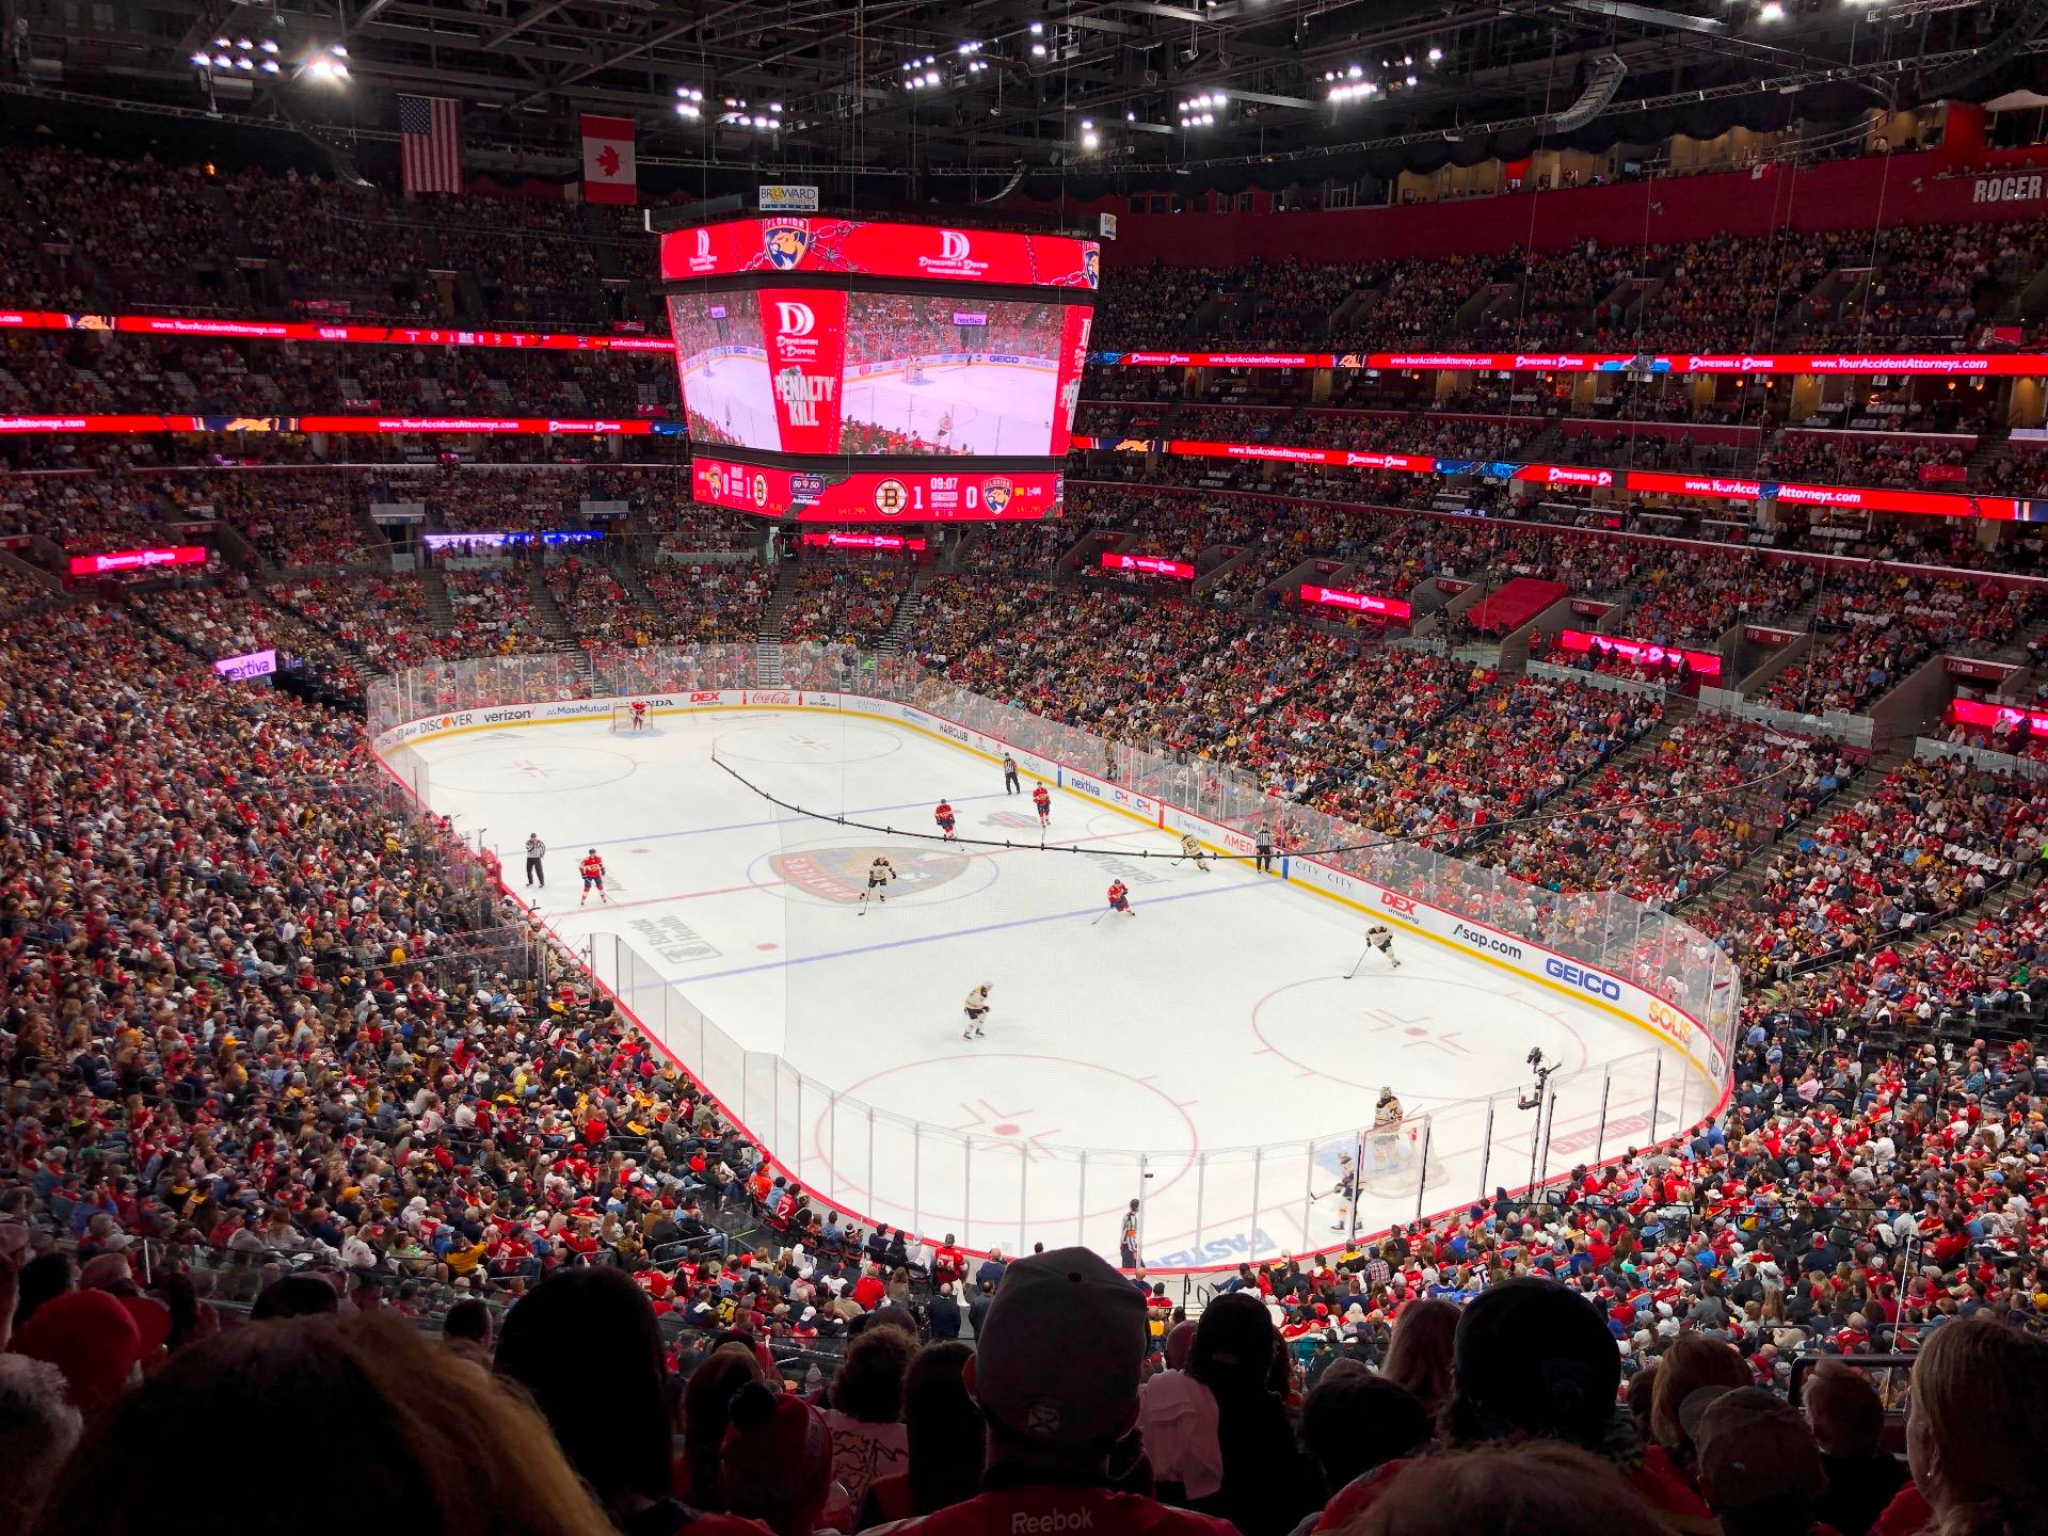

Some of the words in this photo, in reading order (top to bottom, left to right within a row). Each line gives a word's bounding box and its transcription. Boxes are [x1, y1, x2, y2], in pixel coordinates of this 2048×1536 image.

[1973, 176, 2042, 203] ROGER
[767, 217, 805, 229] FLORIDA
[152, 320, 286, 335] www.YourAccidentAttorneys.com
[989, 355, 1020, 364] GEICO
[1209, 356, 1305, 365] www.YourAccidentAttorneys.com
[1391, 357, 1492, 367] www.YourAccidentAttorneys.com
[1690, 357, 1733, 370] DEMESMIN
[1742, 357, 1773, 370] DOVER
[1811, 358, 1987, 372] www.YourAccidentAttorneys.com
[775, 375, 836, 405] PENALTY
[789, 400, 820, 427] KILL
[379, 419, 519, 431] www.YourAccidentAttorneys.com
[1549, 467, 1590, 481] DEMESMIN
[931, 477, 958, 490] 09:07
[884, 488, 898, 507] B
[913, 486, 923, 510] 1
[966, 486, 977, 509] 0
[690, 692, 720, 703] DEX
[752, 691, 790, 705] Coca-Cola
[484, 708, 531, 723] verizon
[557, 703, 610, 716] MassMutual
[420, 714, 473, 734] DISCOVER
[1071, 777, 1100, 796] nextiva
[1295, 861, 1319, 876] CITY
[1328, 873, 1352, 889] CITY
[1381, 891, 1419, 916] DEX
[1388, 907, 1419, 925] imaging
[1452, 924, 1522, 960] Asap.com
[1546, 957, 1620, 1001] GEICO
[1648, 1000, 1692, 1045] SOLIS
[1011, 1506, 1093, 1535] Reebok
